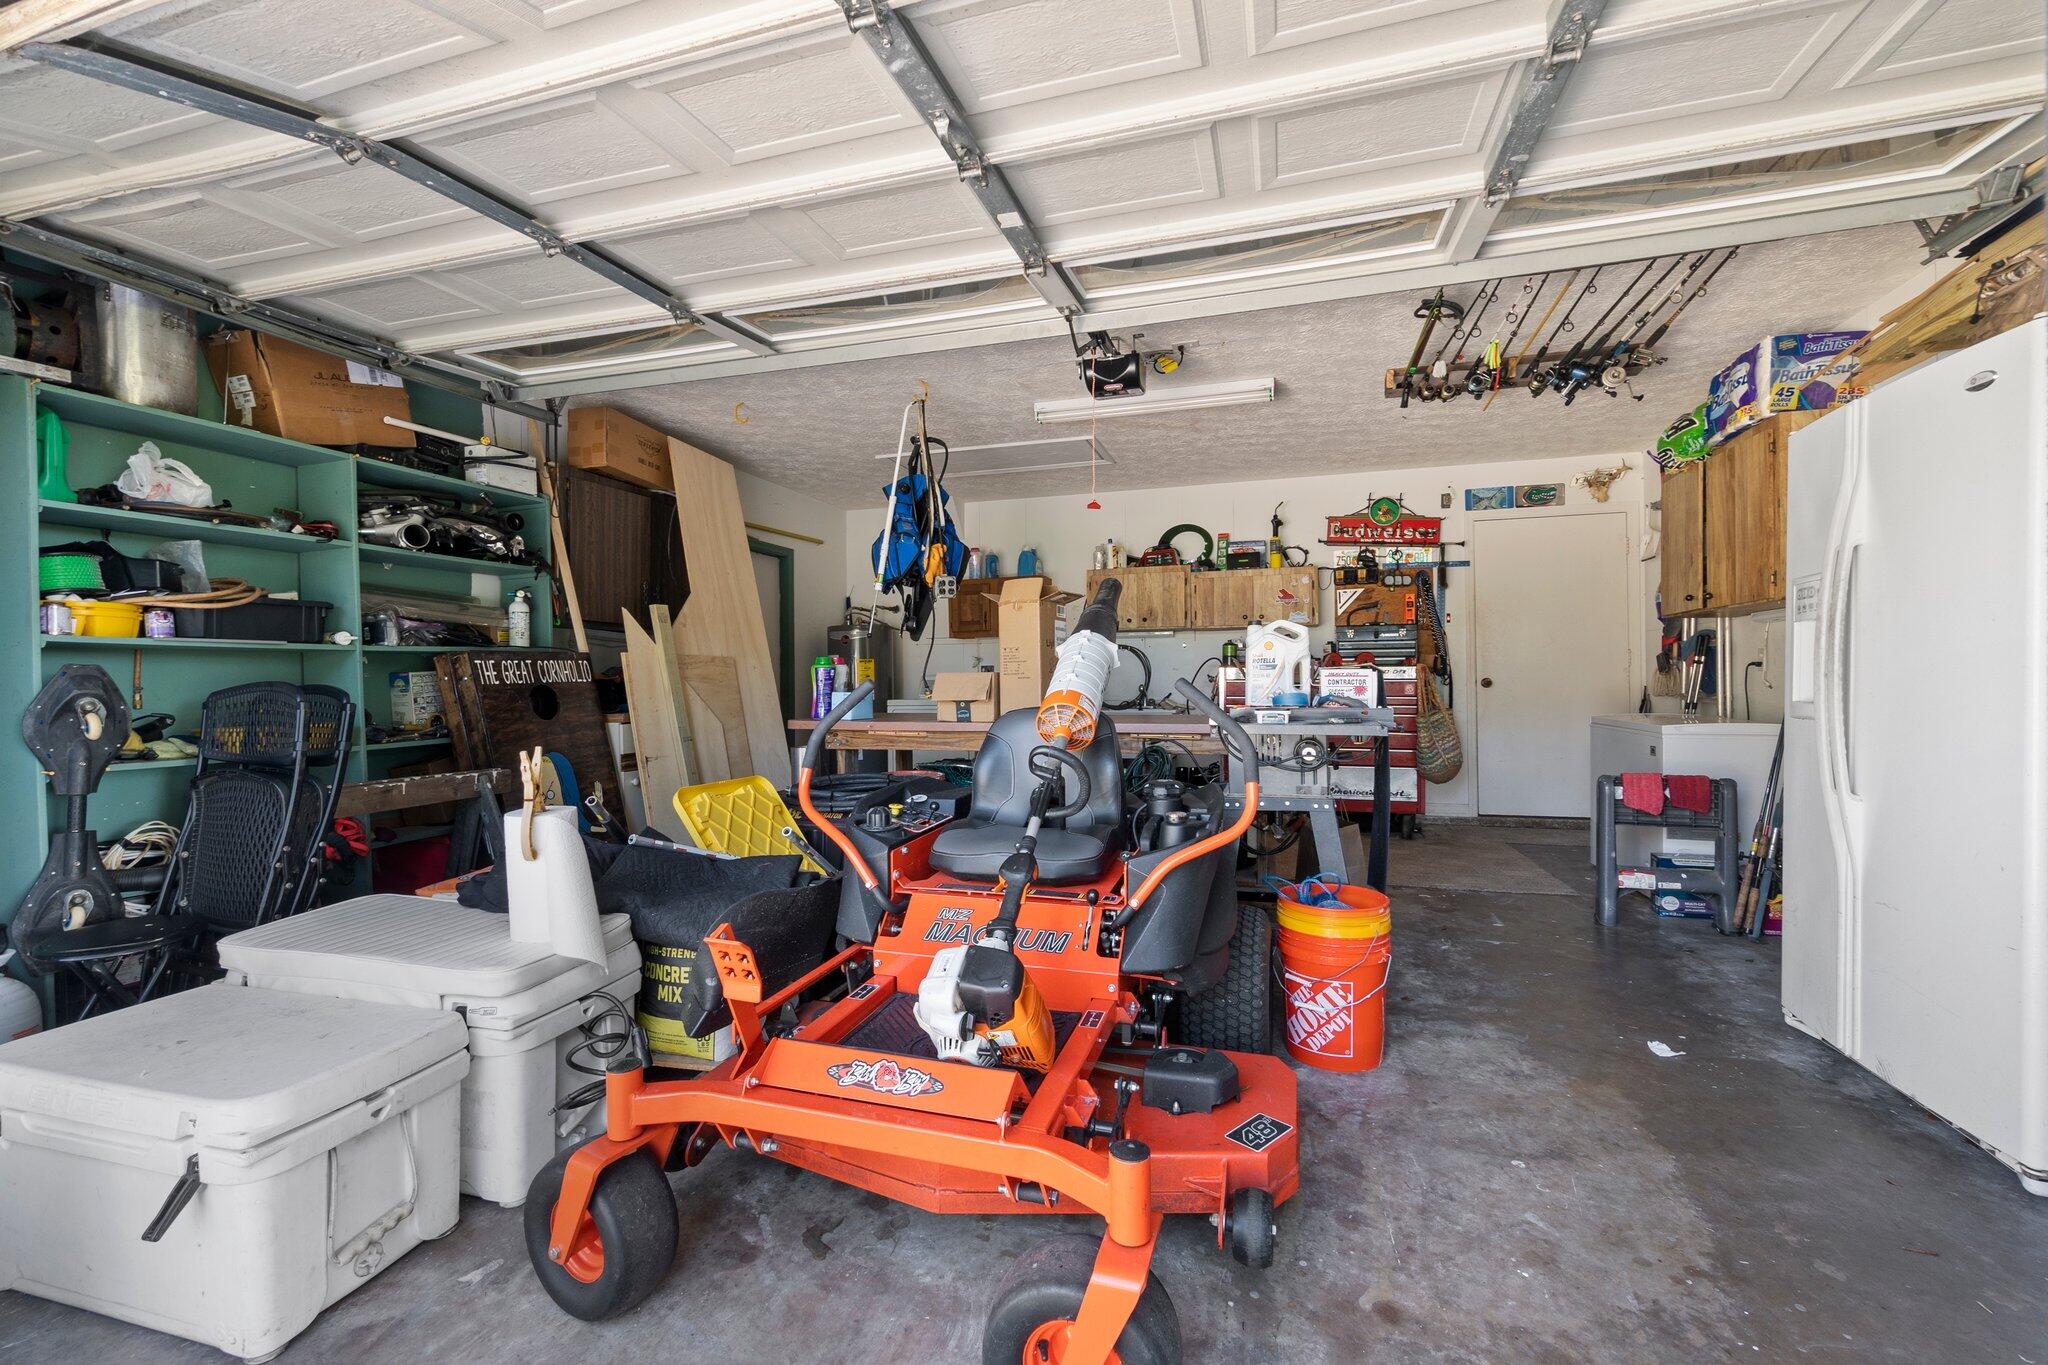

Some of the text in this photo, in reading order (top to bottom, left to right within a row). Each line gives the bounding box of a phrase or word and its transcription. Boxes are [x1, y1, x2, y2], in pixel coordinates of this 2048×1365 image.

[1803, 340, 1830, 355] Bath
[1775, 387, 1795, 398] 45
[1329, 520, 1440, 539] Budweiser
[474, 660, 592, 685] THE GREAT CORNHOLIO
[936, 907, 974, 921] MZ
[923, 921, 1073, 954] MAGUM
[645, 962, 690, 984] CONCRE
[657, 984, 683, 1004] MIX
[1287, 982, 1352, 1045] HOME
[1306, 1010, 1352, 1051] DEPOT
